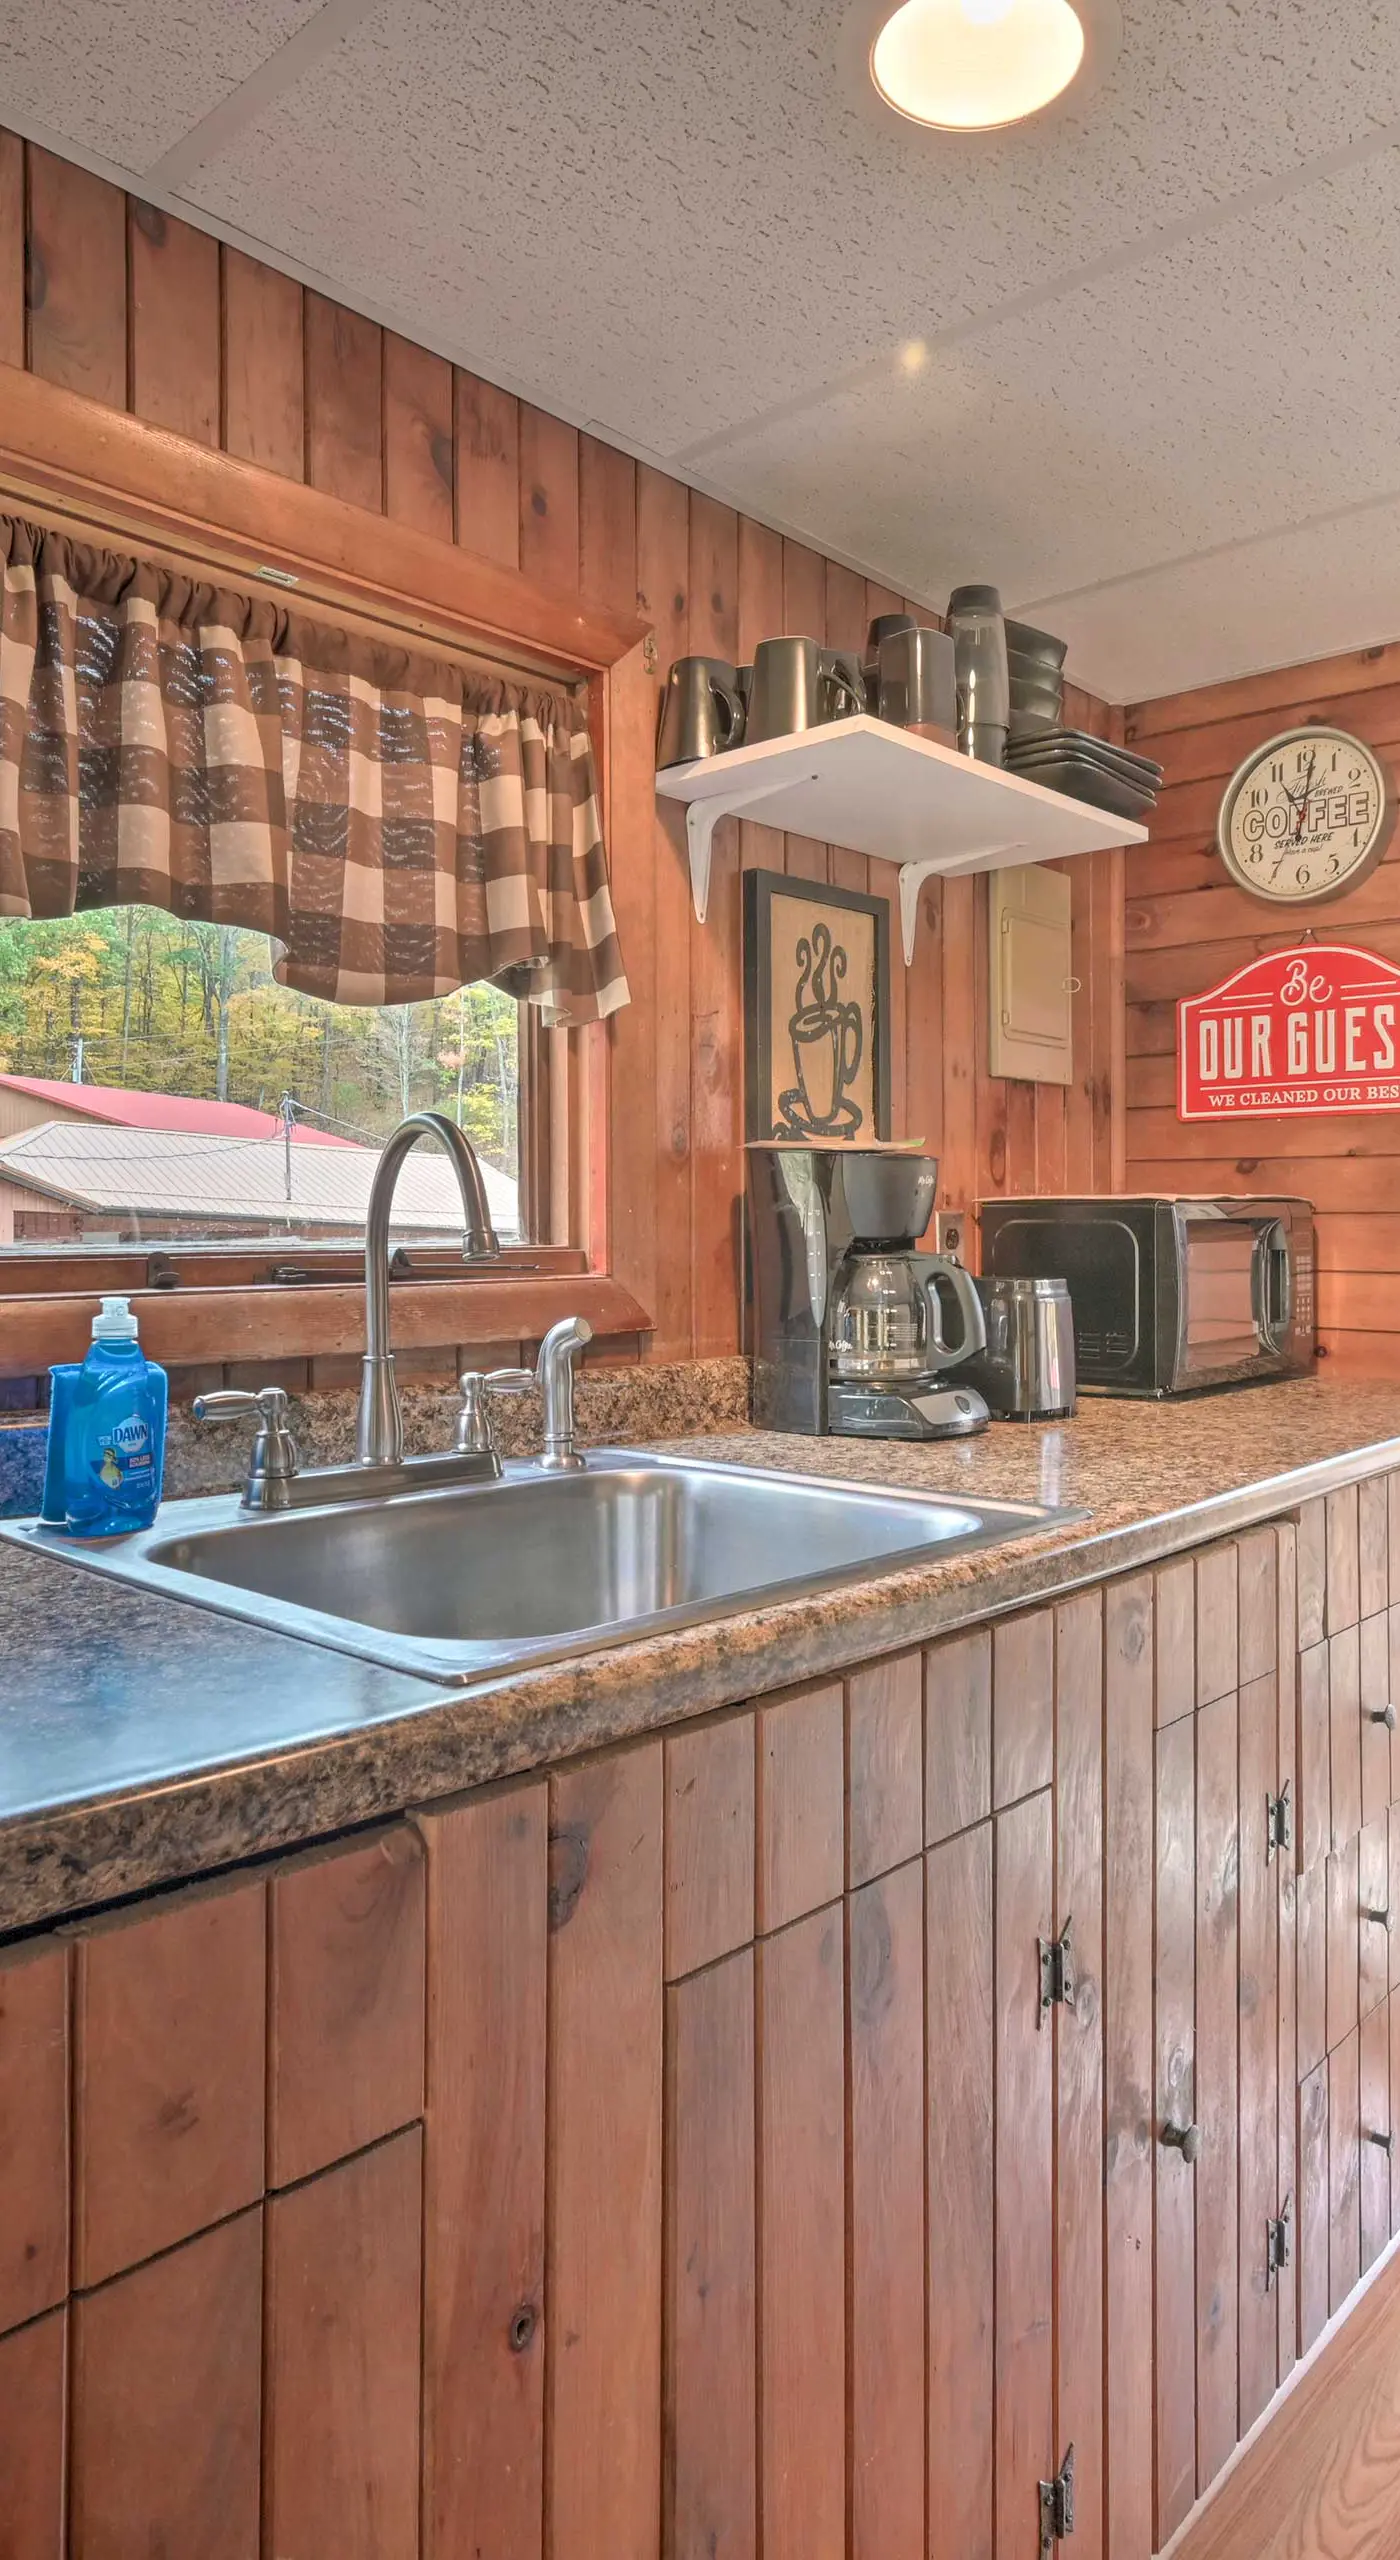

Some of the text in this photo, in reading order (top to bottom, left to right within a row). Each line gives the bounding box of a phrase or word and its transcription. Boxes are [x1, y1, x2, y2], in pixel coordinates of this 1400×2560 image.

[1331, 751, 1337, 772] 1
[1271, 763, 1284, 783] 11
[1348, 768, 1361, 788] 2
[1251, 787, 1268, 808] 10
[1314, 785, 1344, 798] BREWED
[1243, 791, 1370, 842] COFFEE
[1310, 832, 1335, 845] HERE
[1249, 844, 1263, 864] 8
[1325, 853, 1340, 874] 5
[1272, 859, 1284, 880] 7
[1296, 864, 1310, 884] 6
[1280, 959, 1333, 1006] Be
[1200, 1004, 1396, 1081] OUR GUES
[1208, 1093, 1236, 1107] WE
[1239, 1089, 1318, 1106] CLEANED
[1323, 1086, 1361, 1101] OUR
[113, 1424, 148, 1443] DAWN
